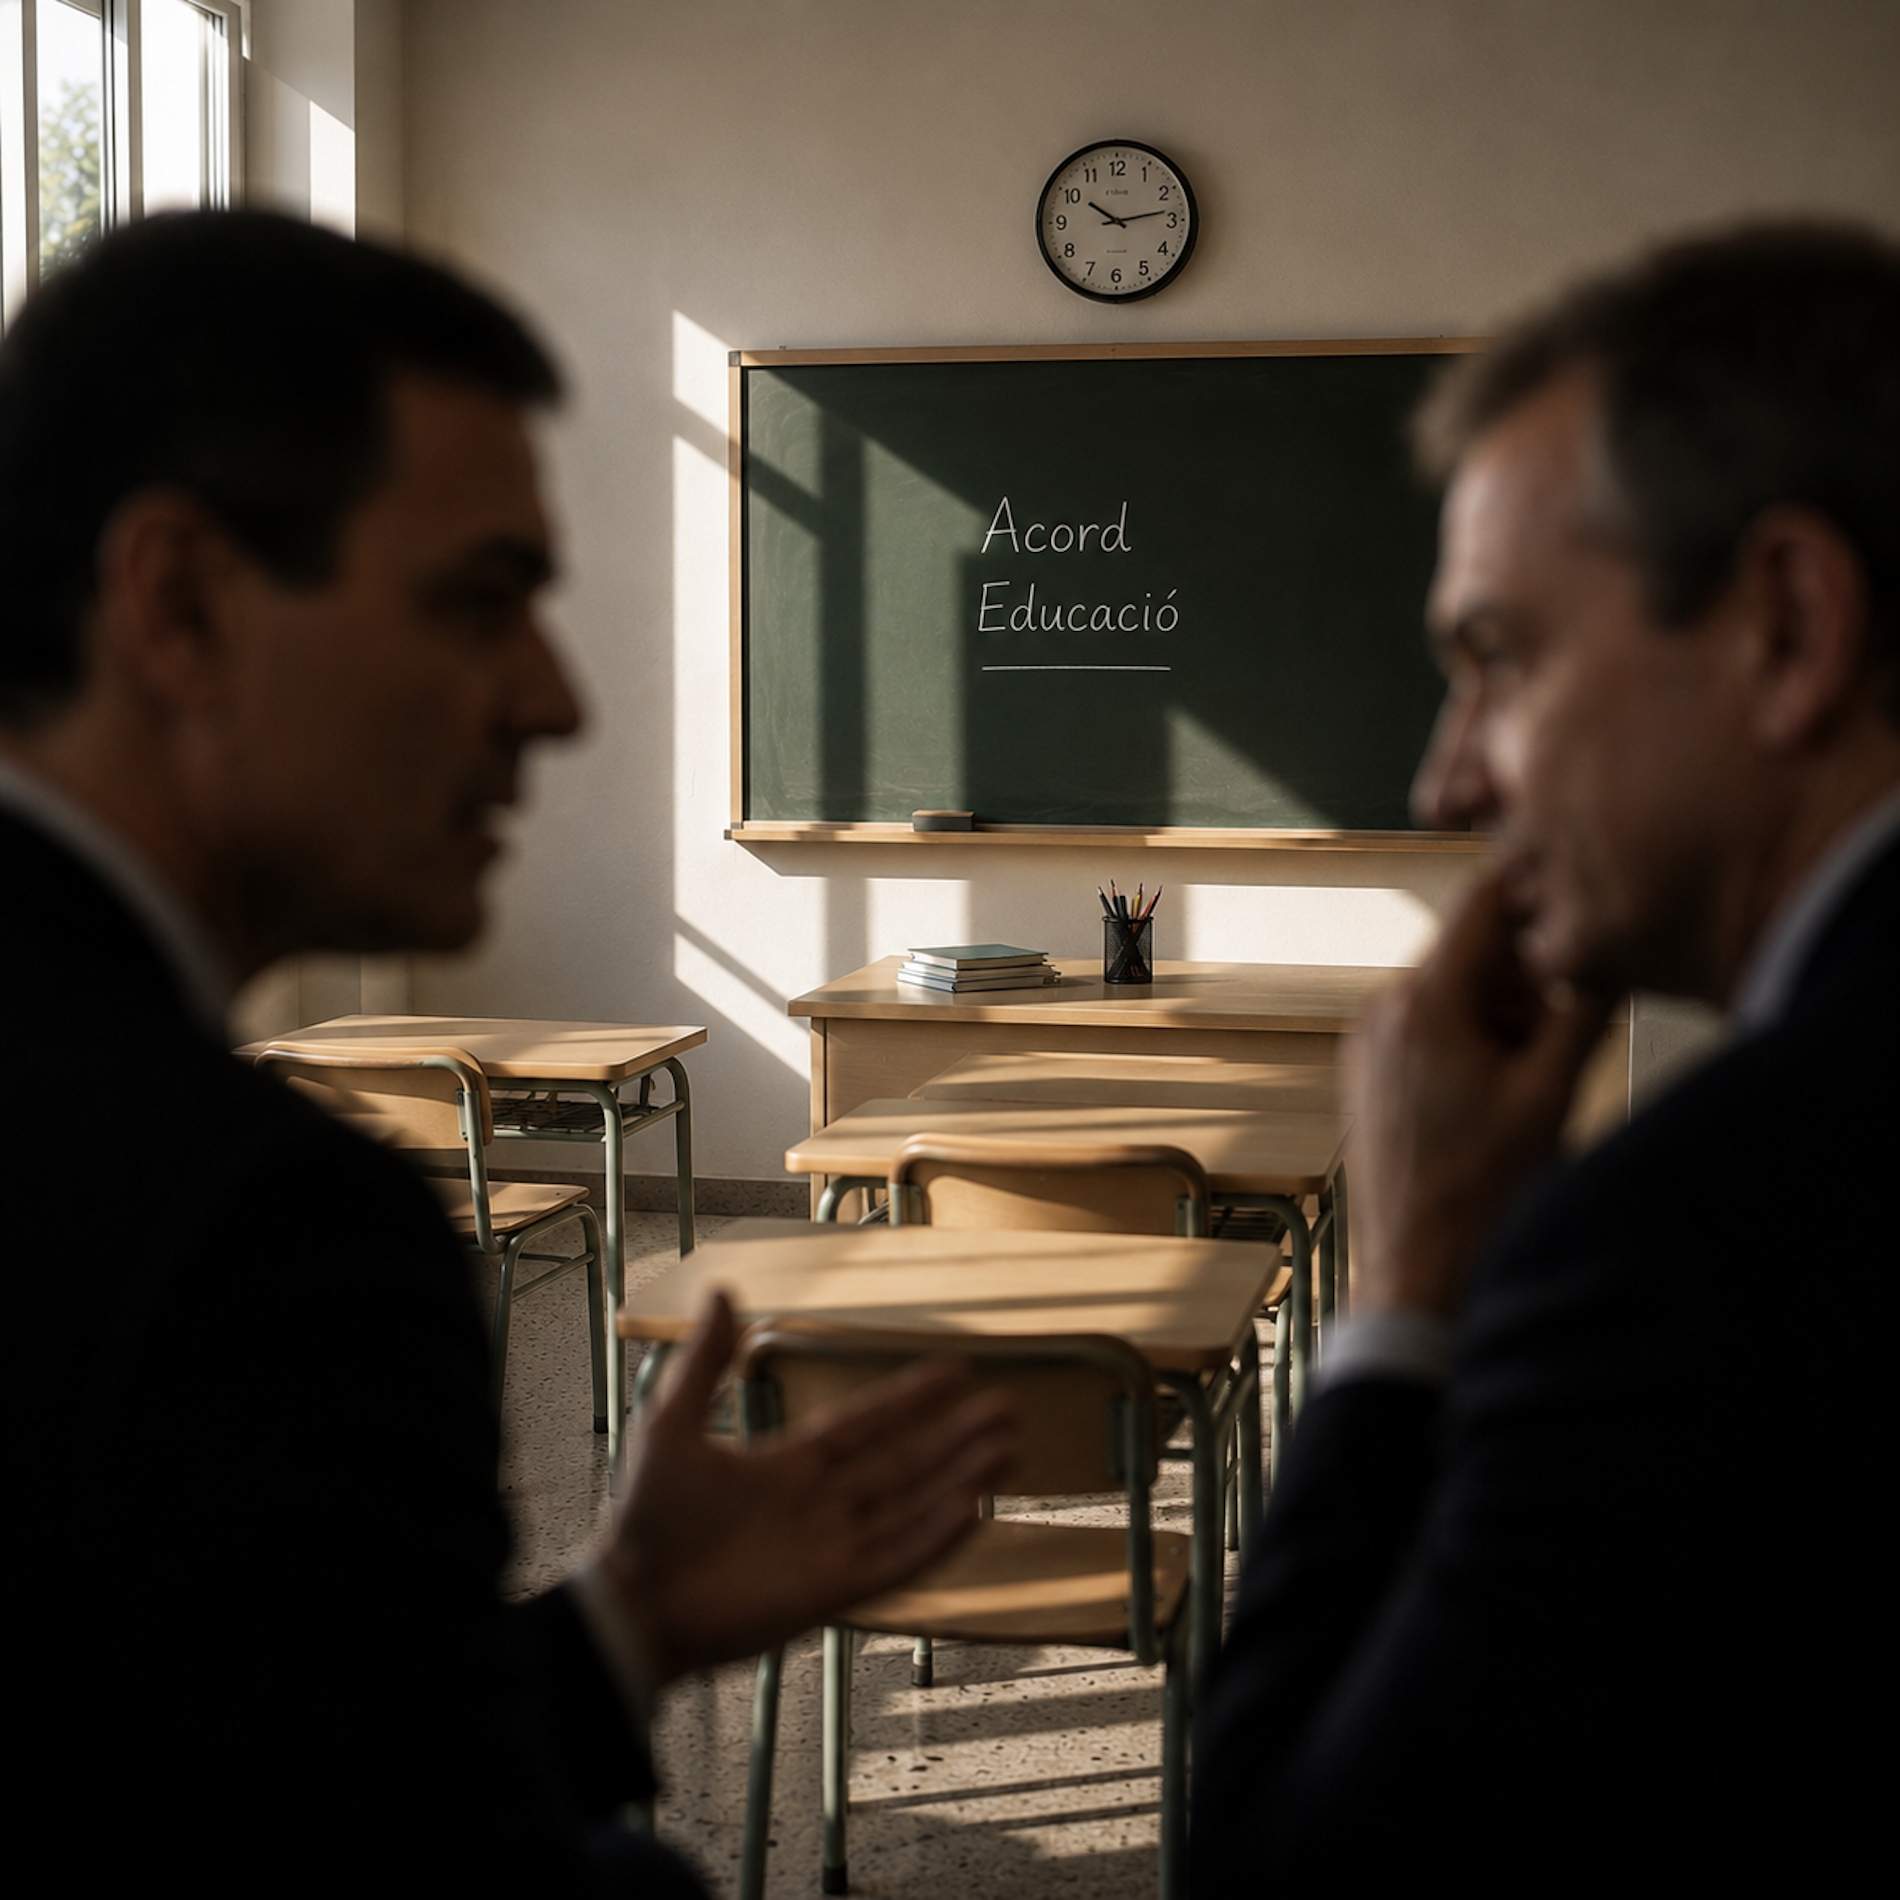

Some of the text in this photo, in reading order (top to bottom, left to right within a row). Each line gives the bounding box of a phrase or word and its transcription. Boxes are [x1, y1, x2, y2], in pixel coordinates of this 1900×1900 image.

[1084, 168, 1098, 184] 11
[1108, 160, 1127, 177] 12
[1141, 166, 1148, 183] 1
[1063, 187, 1081, 204] 10
[1158, 185, 1170, 202] 2
[1055, 214, 1068, 231] 9
[1166, 211, 1178, 229] 3
[1063, 242, 1076, 259] 8
[1156, 240, 1169, 256] 4
[1085, 261, 1096, 277] 7
[1110, 268, 1123, 284] 6
[1138, 260, 1150, 277] 5
[980, 496, 1132, 554] Acord
[977, 581, 1180, 633] Educació
